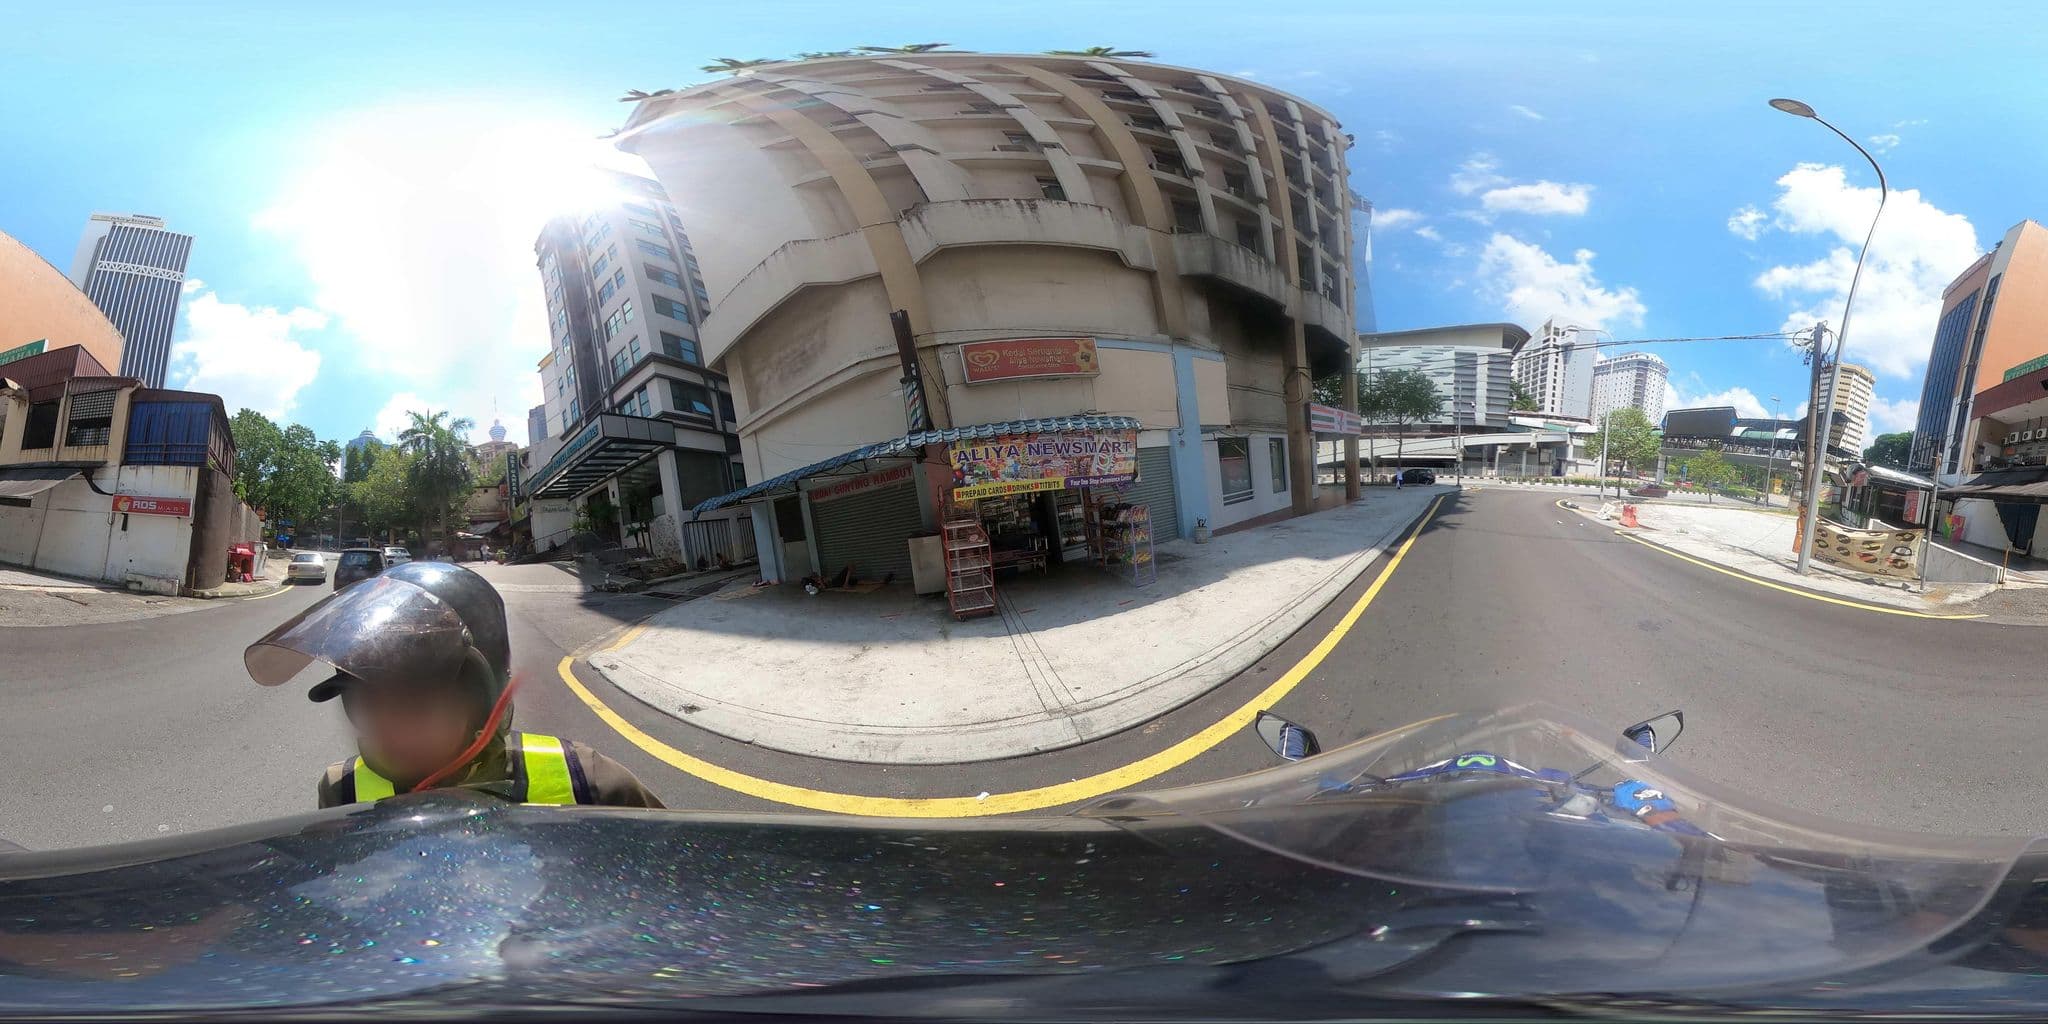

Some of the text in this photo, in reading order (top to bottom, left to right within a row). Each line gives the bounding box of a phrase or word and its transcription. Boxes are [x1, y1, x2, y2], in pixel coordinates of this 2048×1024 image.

[956, 441, 1131, 463] ALIYA NEWSMART
[961, 480, 1060, 499] PREPAID CARDS DRINKS TITBITS
